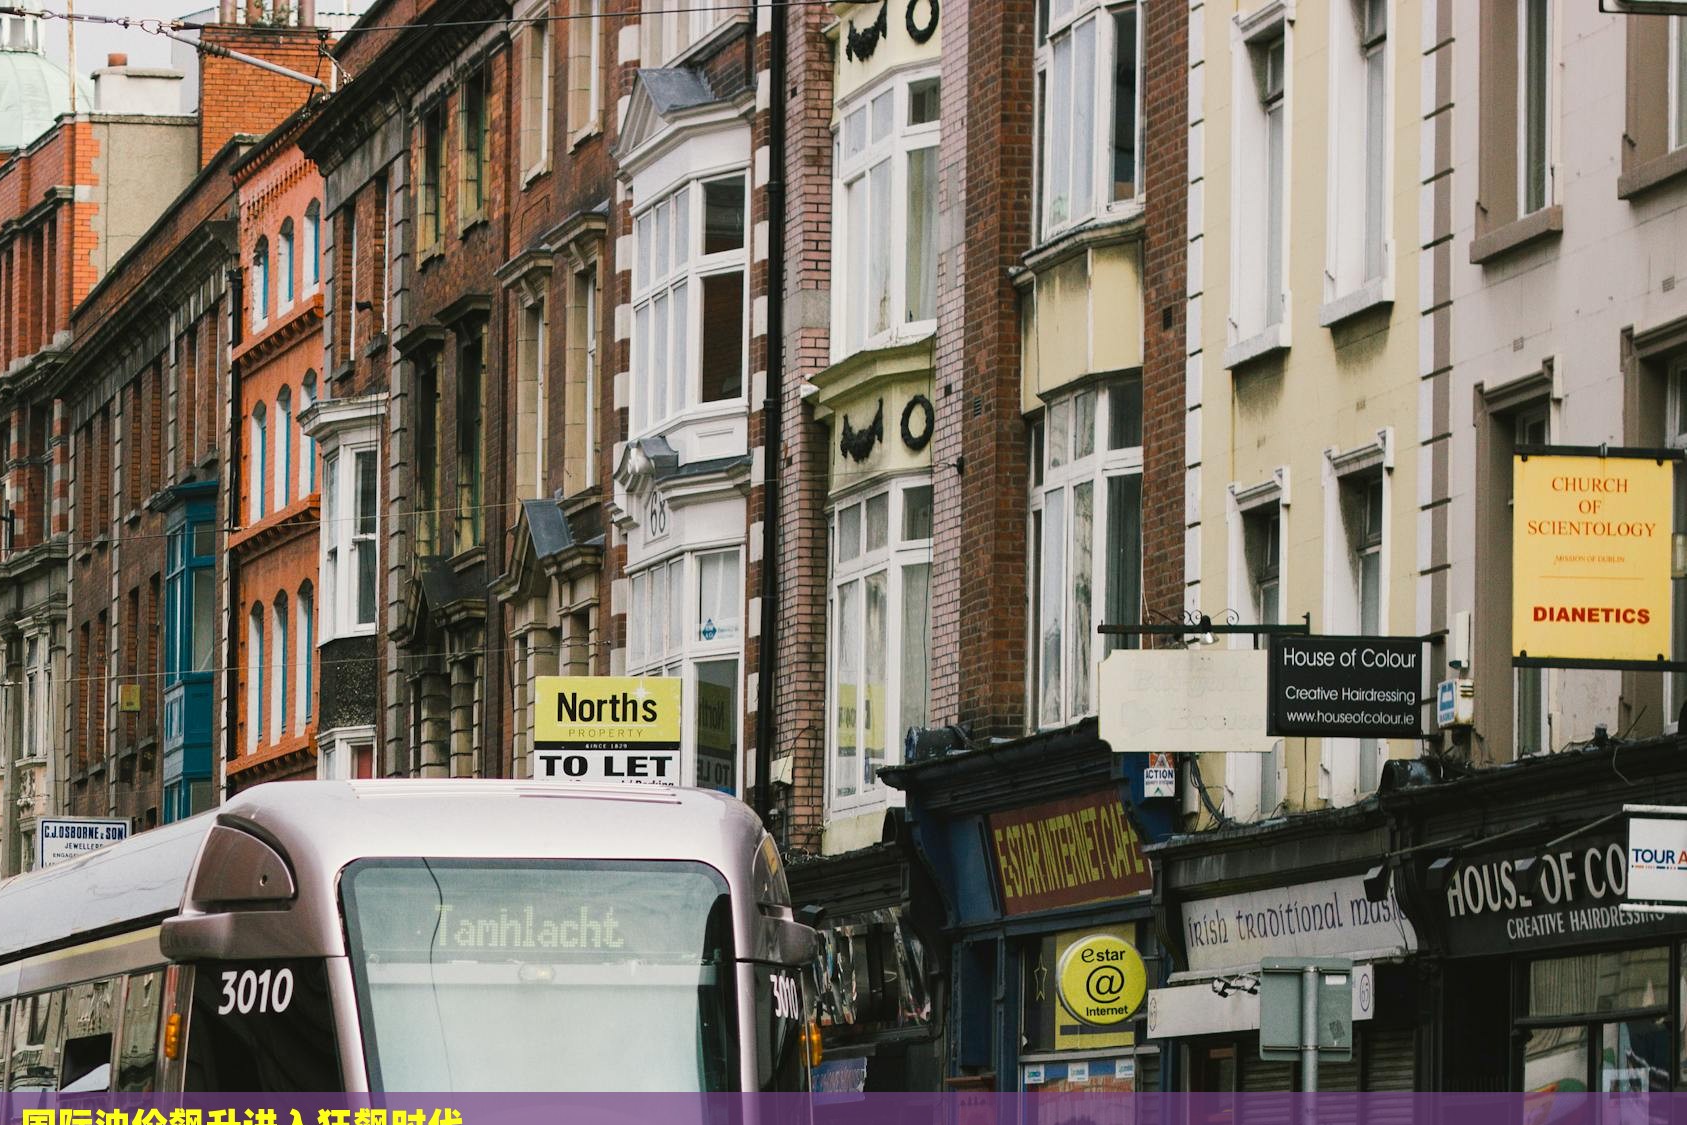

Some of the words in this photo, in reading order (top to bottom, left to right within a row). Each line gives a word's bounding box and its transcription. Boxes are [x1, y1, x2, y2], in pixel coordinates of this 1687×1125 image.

[1551, 477, 1629, 494] CHURCH
[1578, 499, 1602, 514] OF
[1527, 520, 1657, 537] SCIENTOLOGY
[1532, 606, 1651, 625] DIANETICS
[1283, 647, 1335, 667] House
[1339, 647, 1357, 667] of
[1361, 648, 1417, 669] Colour
[1284, 685, 1339, 701] Creative
[1341, 687, 1416, 705] Hairdressing
[556, 692, 658, 723] Norths
[1286, 710, 1415, 726] www.houseofcolour.ie
[568, 728, 645, 738] PROPERTY
[539, 755, 588, 777] TO
[604, 755, 673, 777] LET
[105, 827, 124, 841] SON
[1037, 806, 1106, 891] INTERNET
[1100, 800, 1145, 881] CAFE
[1631, 848, 1676, 864] TOUR
[1447, 859, 1533, 917] HOUS
[1540, 851, 1577, 905] OF
[433, 905, 624, 948] Tamhlacht
[1236, 891, 1344, 942] traditional
[1506, 911, 1565, 939] CREATIVE
[1569, 901, 1665, 933] HAIRDRESSING
[217, 967, 294, 1016] 3010
[769, 974, 799, 1021] 3010
[1085, 1005, 1129, 1017] Internet
